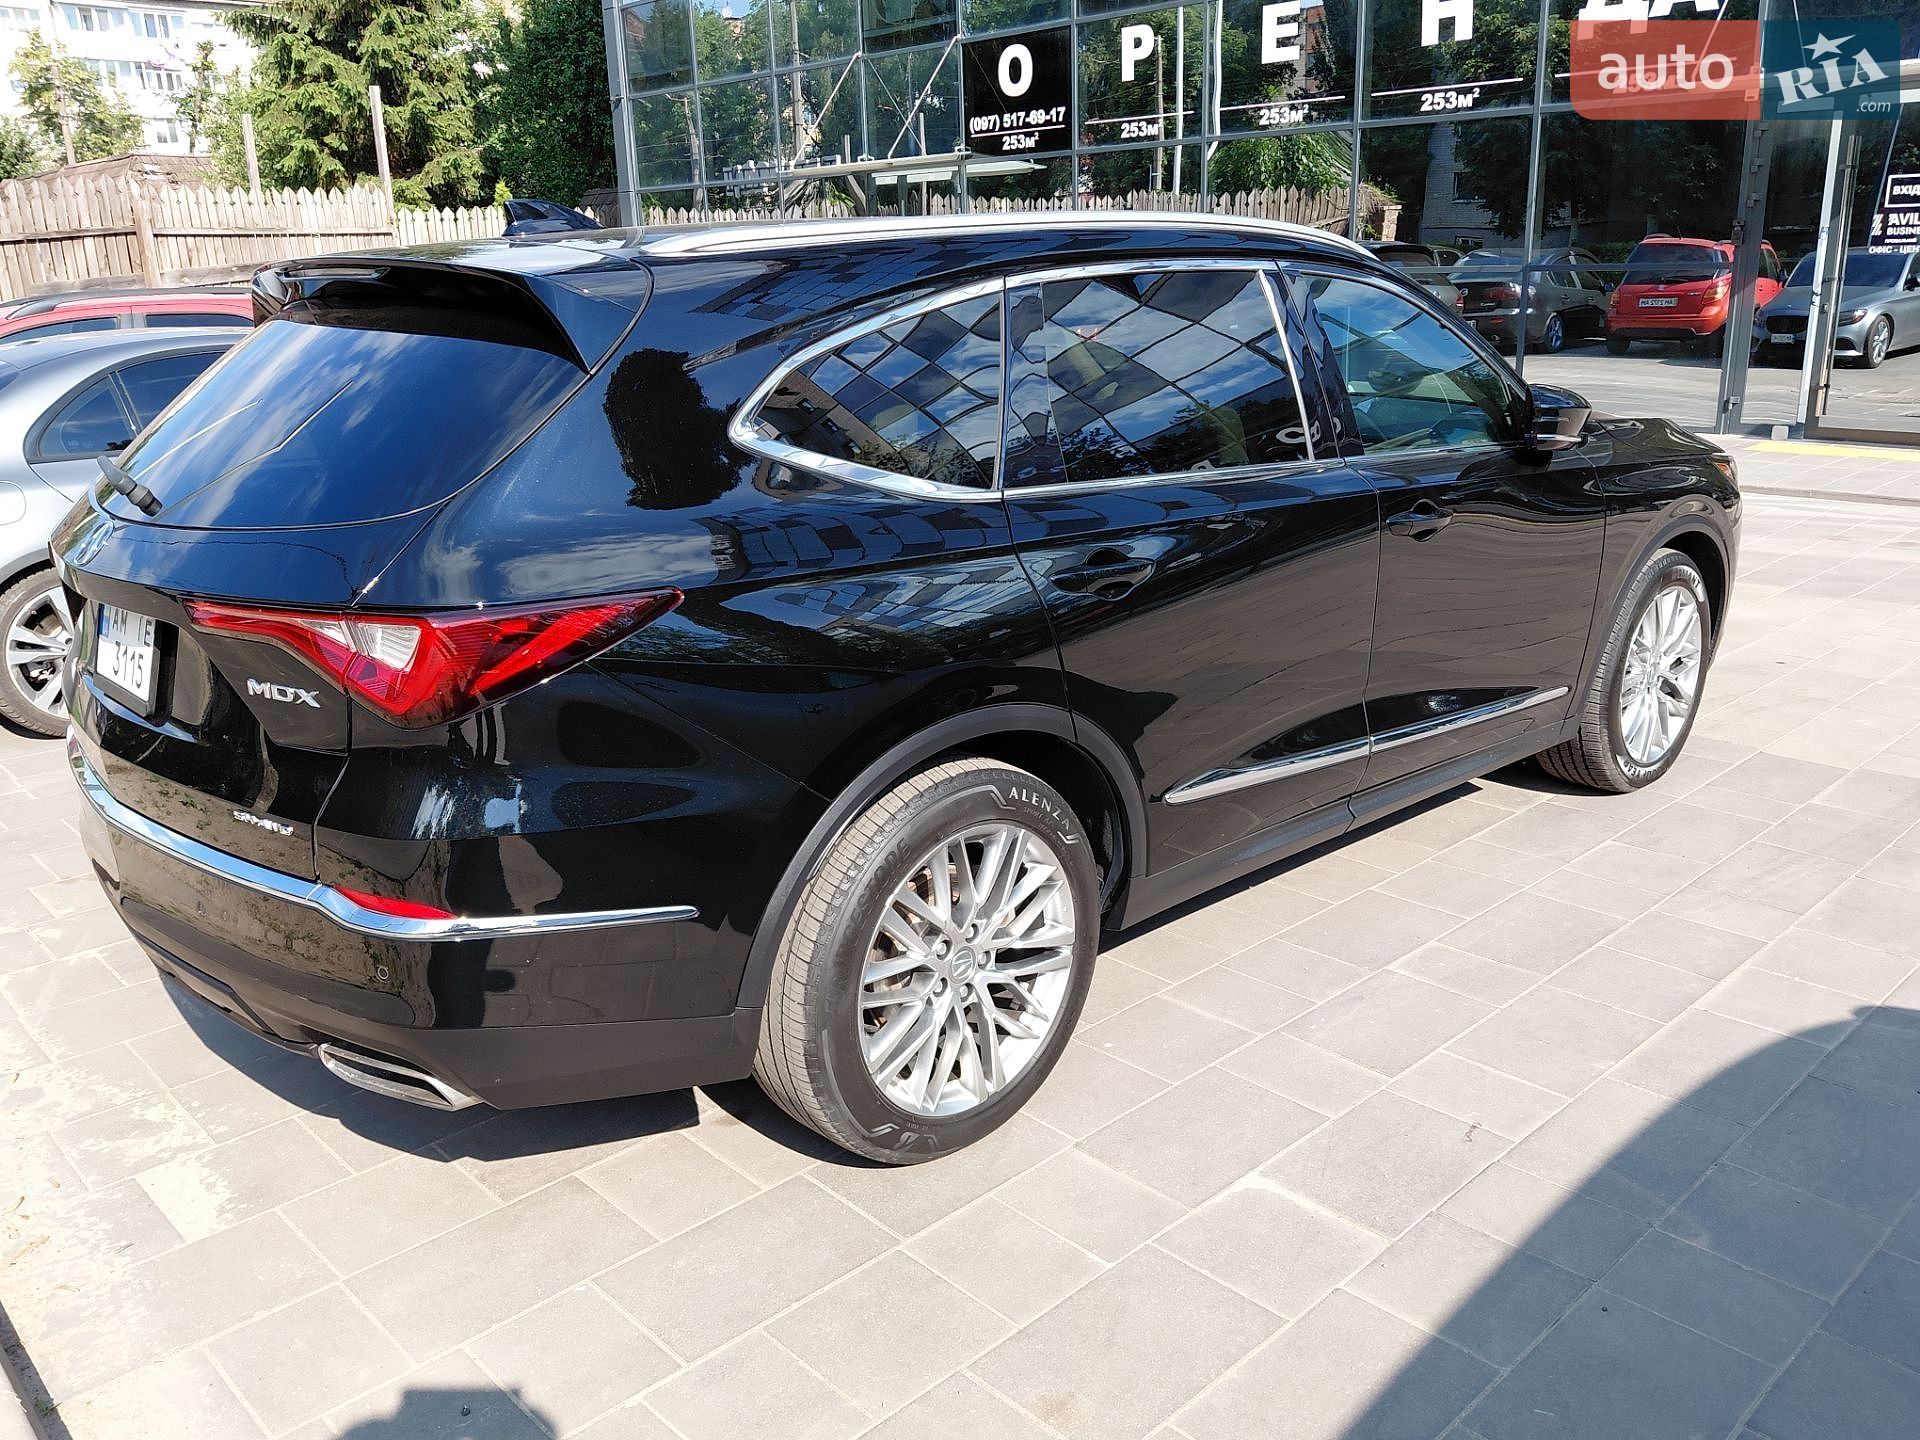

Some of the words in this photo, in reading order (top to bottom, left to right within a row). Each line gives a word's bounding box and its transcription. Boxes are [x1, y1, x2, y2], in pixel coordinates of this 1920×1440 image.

[969, 114, 1000, 134] (097)
[1002, 106, 1066, 128] 517-69-17
[112, 640, 145, 690] 3115
[246, 677, 321, 709] MDX
[1008, 786, 1071, 832] ALENZA
